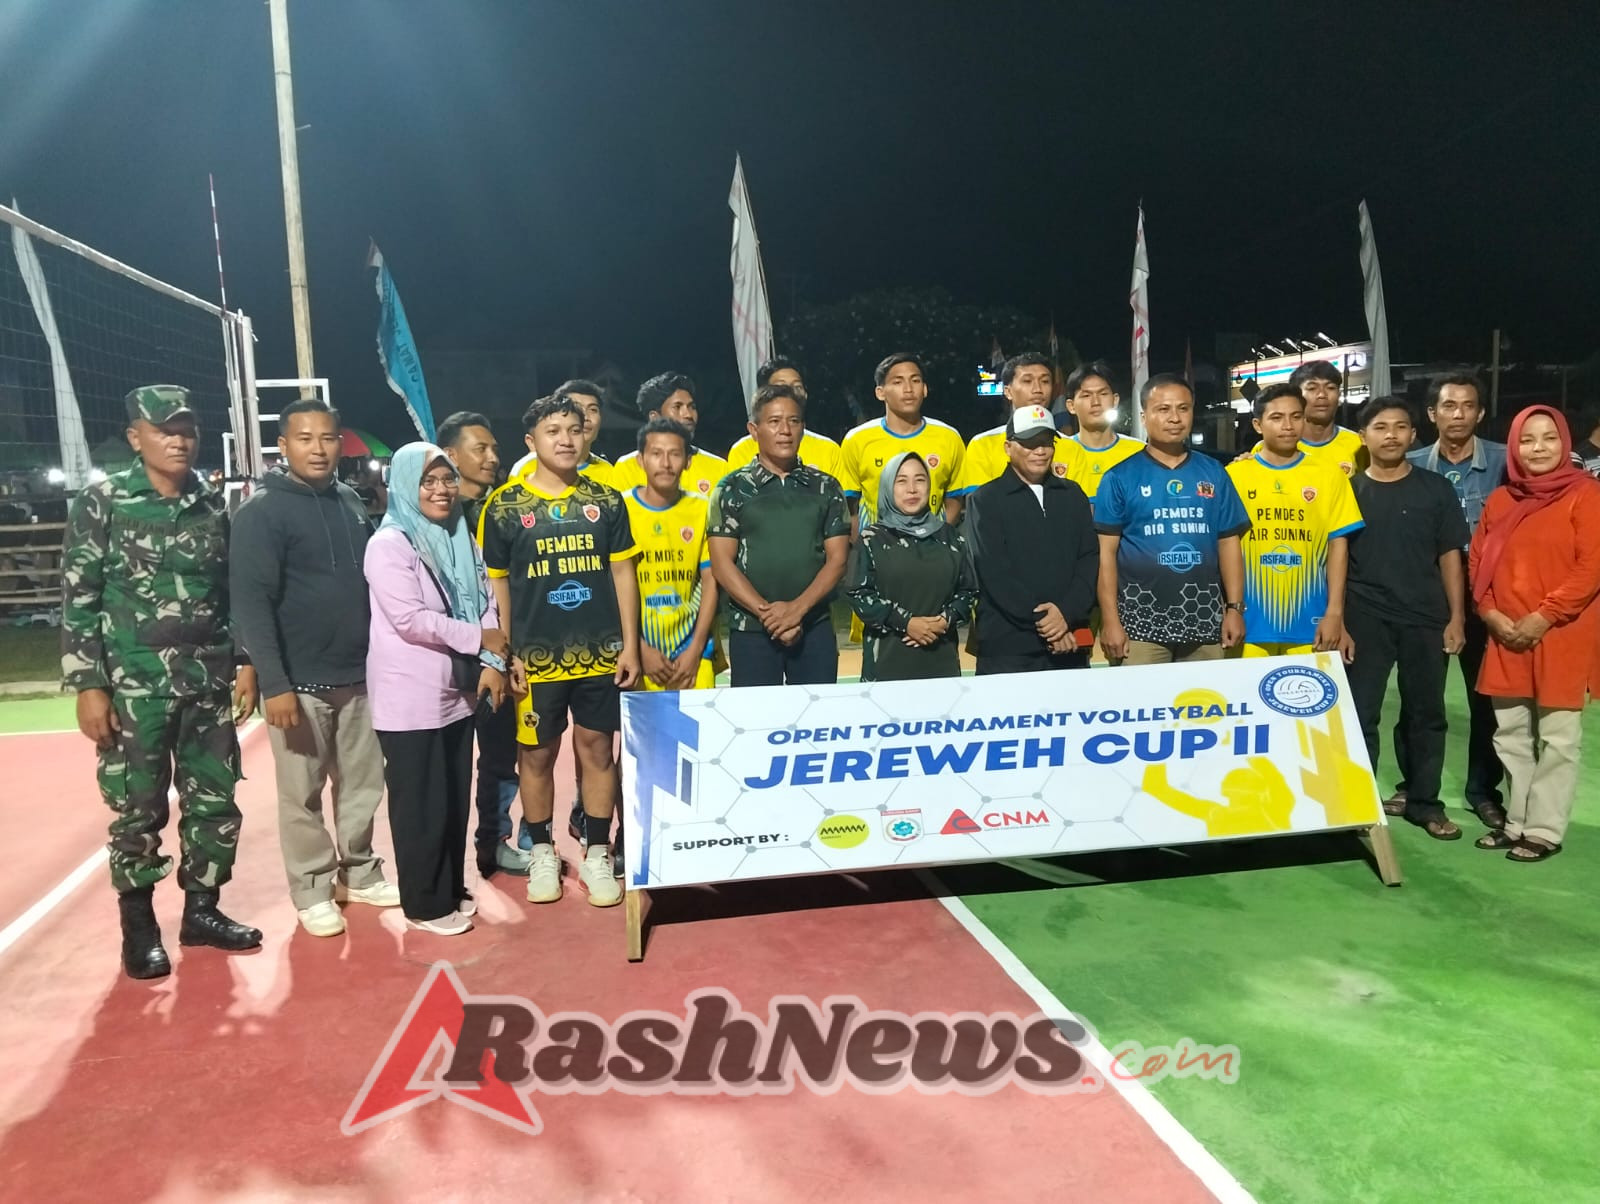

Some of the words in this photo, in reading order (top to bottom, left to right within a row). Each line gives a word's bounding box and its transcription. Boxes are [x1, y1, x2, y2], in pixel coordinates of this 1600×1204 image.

[1153, 507, 1204, 519] PEMDES
[1257, 508, 1305, 521] PEMDES
[1144, 523, 1165, 536] AIR
[1248, 528, 1269, 541] AIR
[536, 533, 594, 555] PEMDES
[527, 560, 550, 578] AIR
[558, 555, 603, 574] SUNIN
[1315, 699, 1329, 712] CUP
[767, 726, 852, 745] OPEN
[859, 712, 1072, 738] TOURNAMENT
[1078, 702, 1254, 725] VOLLEYBALL
[744, 737, 1066, 789] JEREWEH
[1082, 728, 1218, 765] CUP
[1233, 724, 1270, 756] II
[983, 809, 1050, 828] CNM
[672, 835, 755, 851] SUPPORT
[758, 833, 781, 843] BY
